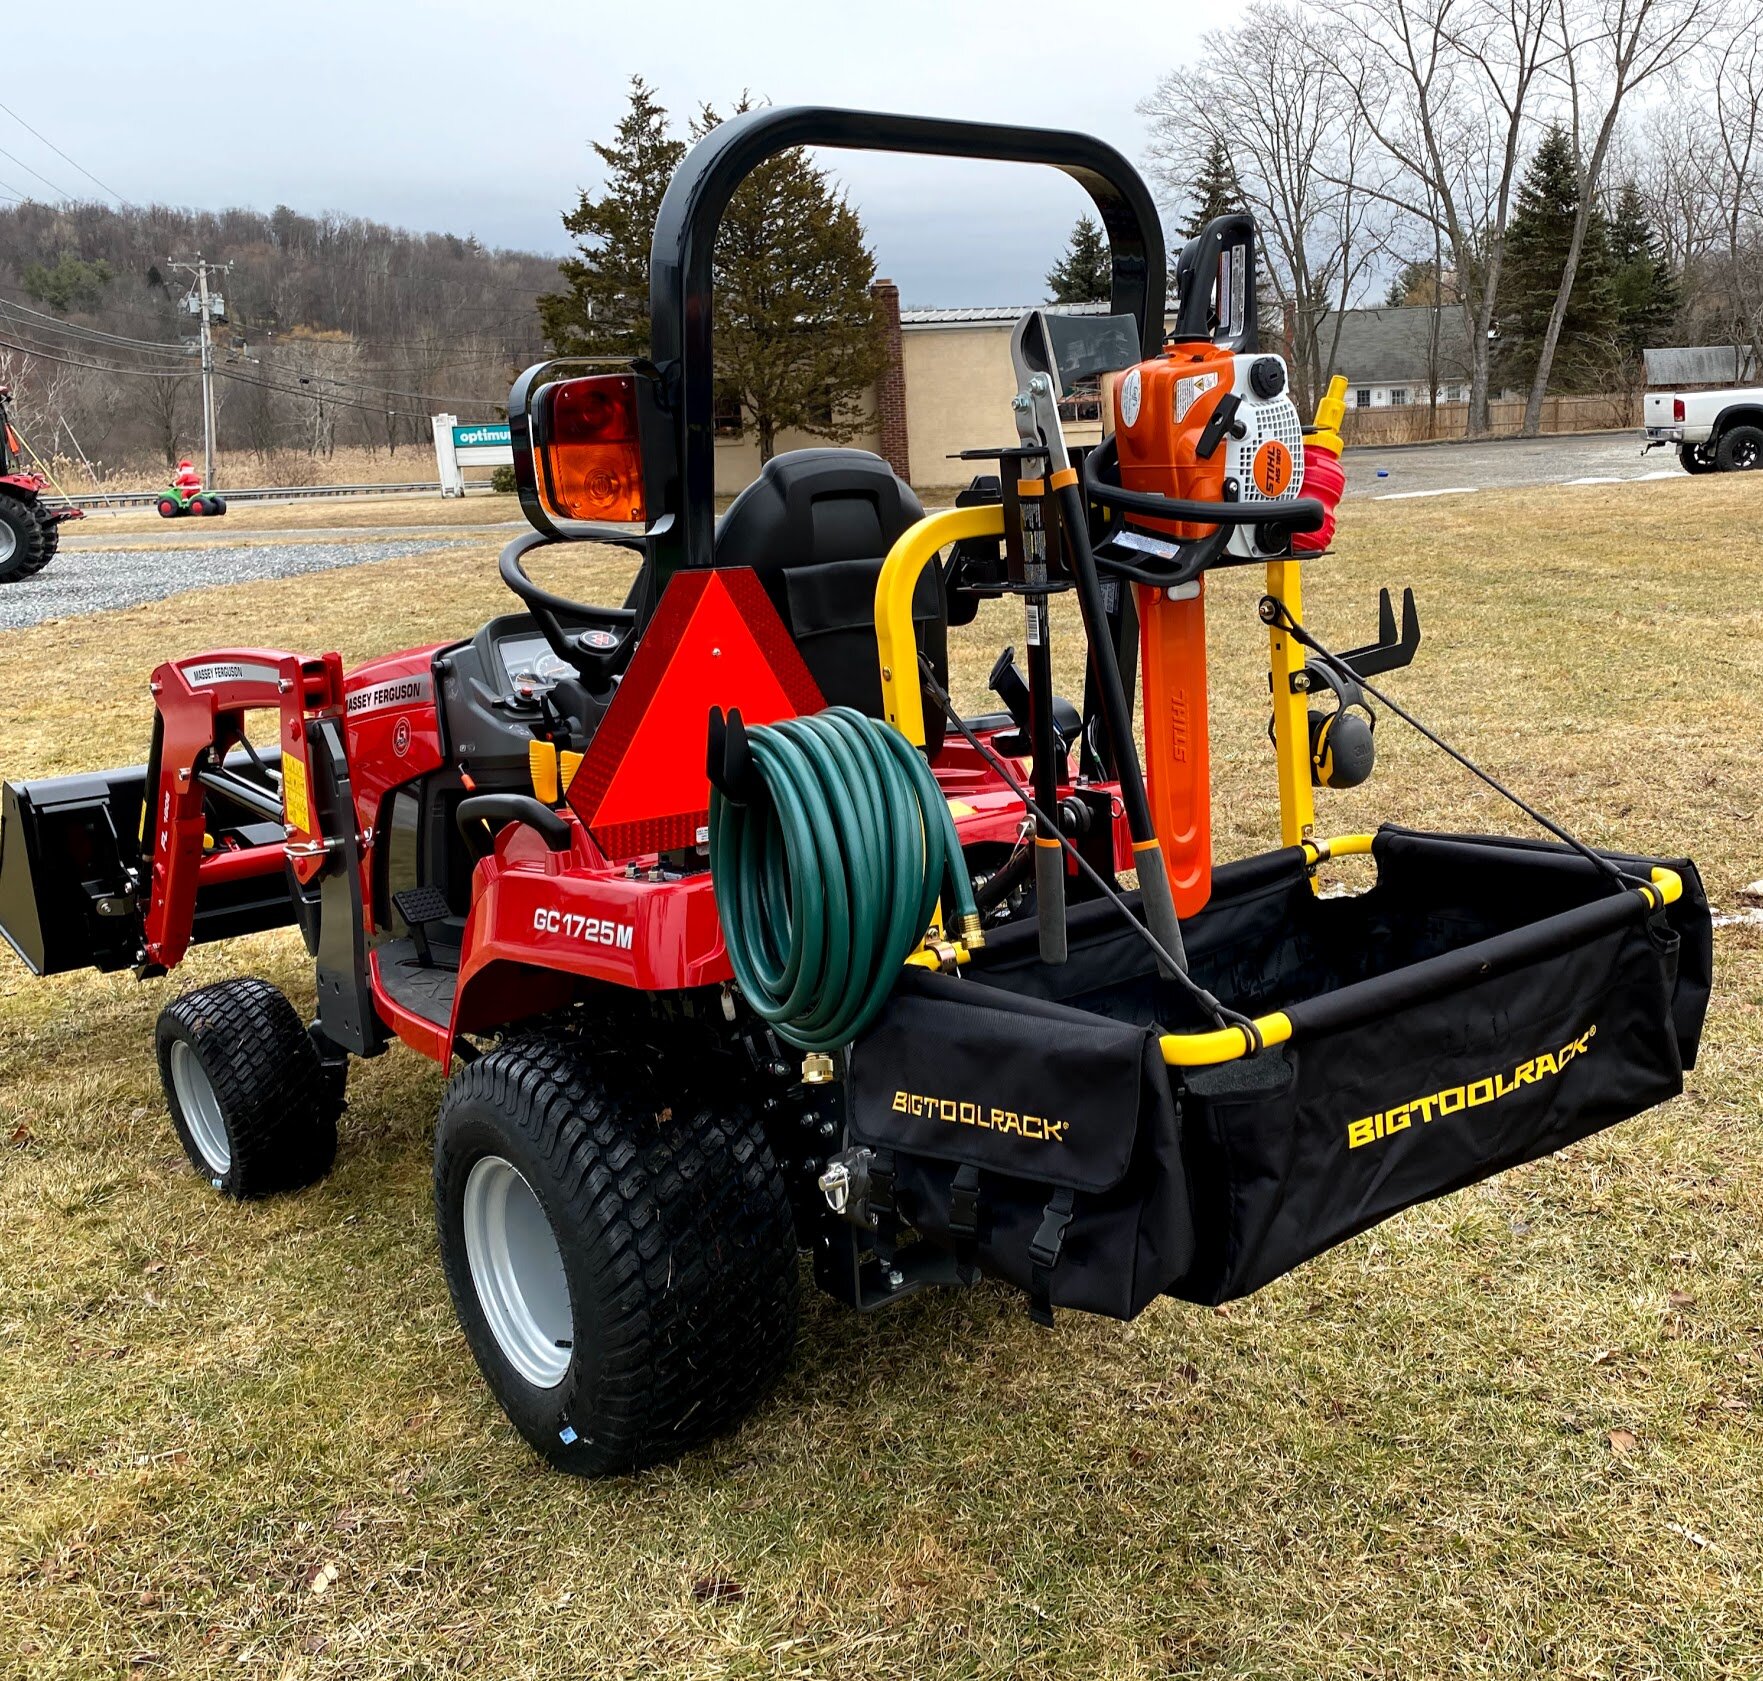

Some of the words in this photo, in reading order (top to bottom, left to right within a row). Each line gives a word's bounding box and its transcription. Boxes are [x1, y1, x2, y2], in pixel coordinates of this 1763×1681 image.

[1265, 445, 1276, 494] STIHL
[1275, 466, 1281, 485] MS
[193, 668, 214, 682] MASSEY
[214, 665, 243, 679] FERGUSON
[345, 692, 372, 713] ASSEY
[373, 682, 421, 706] FERGUSON
[1171, 689, 1186, 764] STIHL
